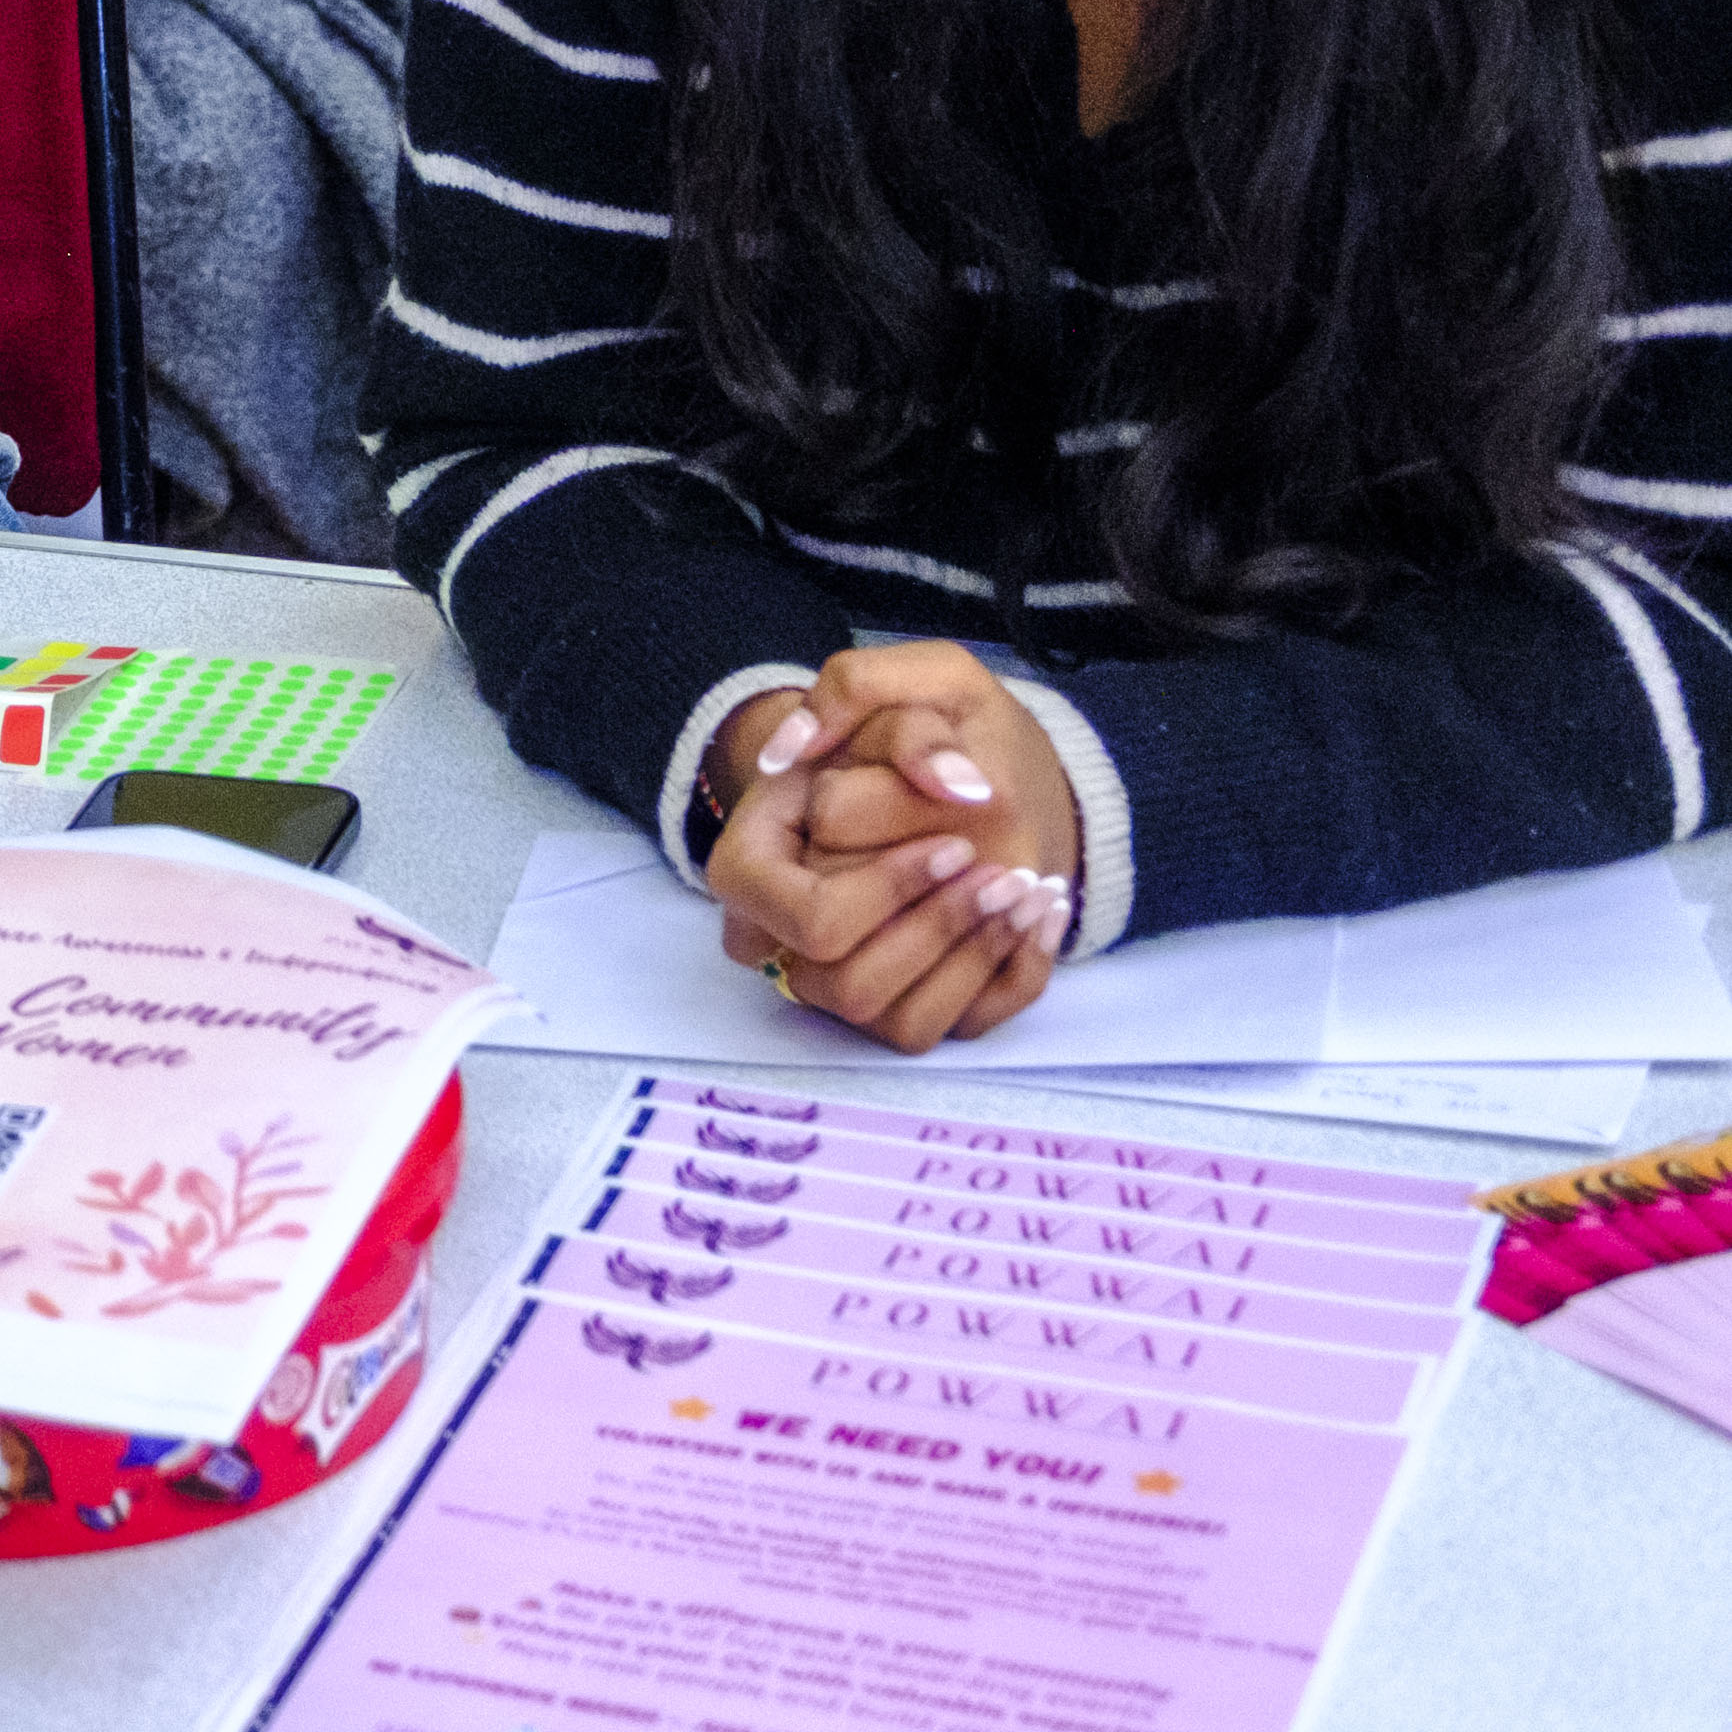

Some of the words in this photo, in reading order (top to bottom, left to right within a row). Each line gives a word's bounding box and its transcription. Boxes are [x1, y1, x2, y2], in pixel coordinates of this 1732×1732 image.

[9, 974, 420, 1062] Community
[914, 1156, 1272, 1228] POWWAI
[895, 1199, 1256, 1274] POWWAI
[884, 1243, 1247, 1323] POWWAI
[831, 1291, 1203, 1369] POWWAI
[810, 1358, 1189, 1441] POWWAI
[736, 1409, 810, 1439] WE
[824, 1422, 963, 1462] NEED
[983, 1446, 1107, 1487] YOU!
